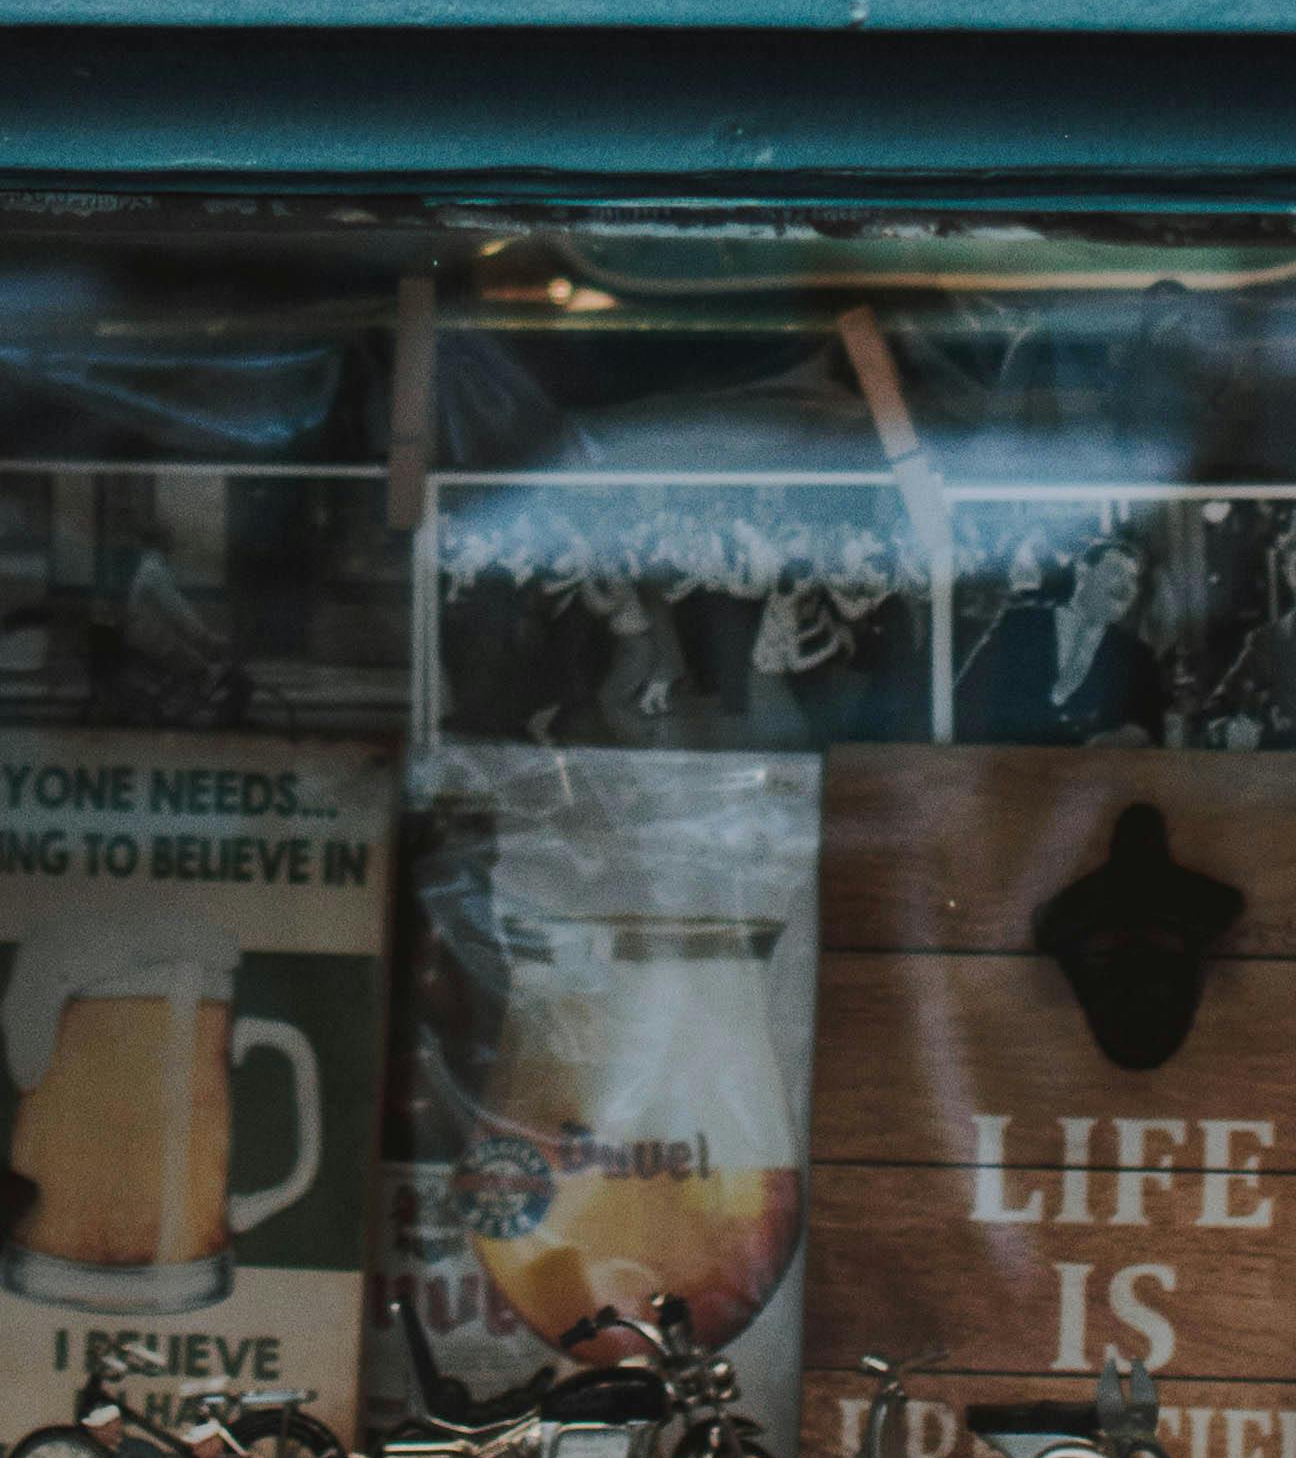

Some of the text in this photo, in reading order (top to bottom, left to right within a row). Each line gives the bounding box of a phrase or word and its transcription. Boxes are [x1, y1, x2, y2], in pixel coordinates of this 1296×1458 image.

[81, 831, 138, 877] TO
[150, 835, 311, 885] BELIEVE
[320, 838, 368, 888] IN
[969, 1115, 1275, 1228] LIFE
[1050, 1262, 1177, 1373] IS
